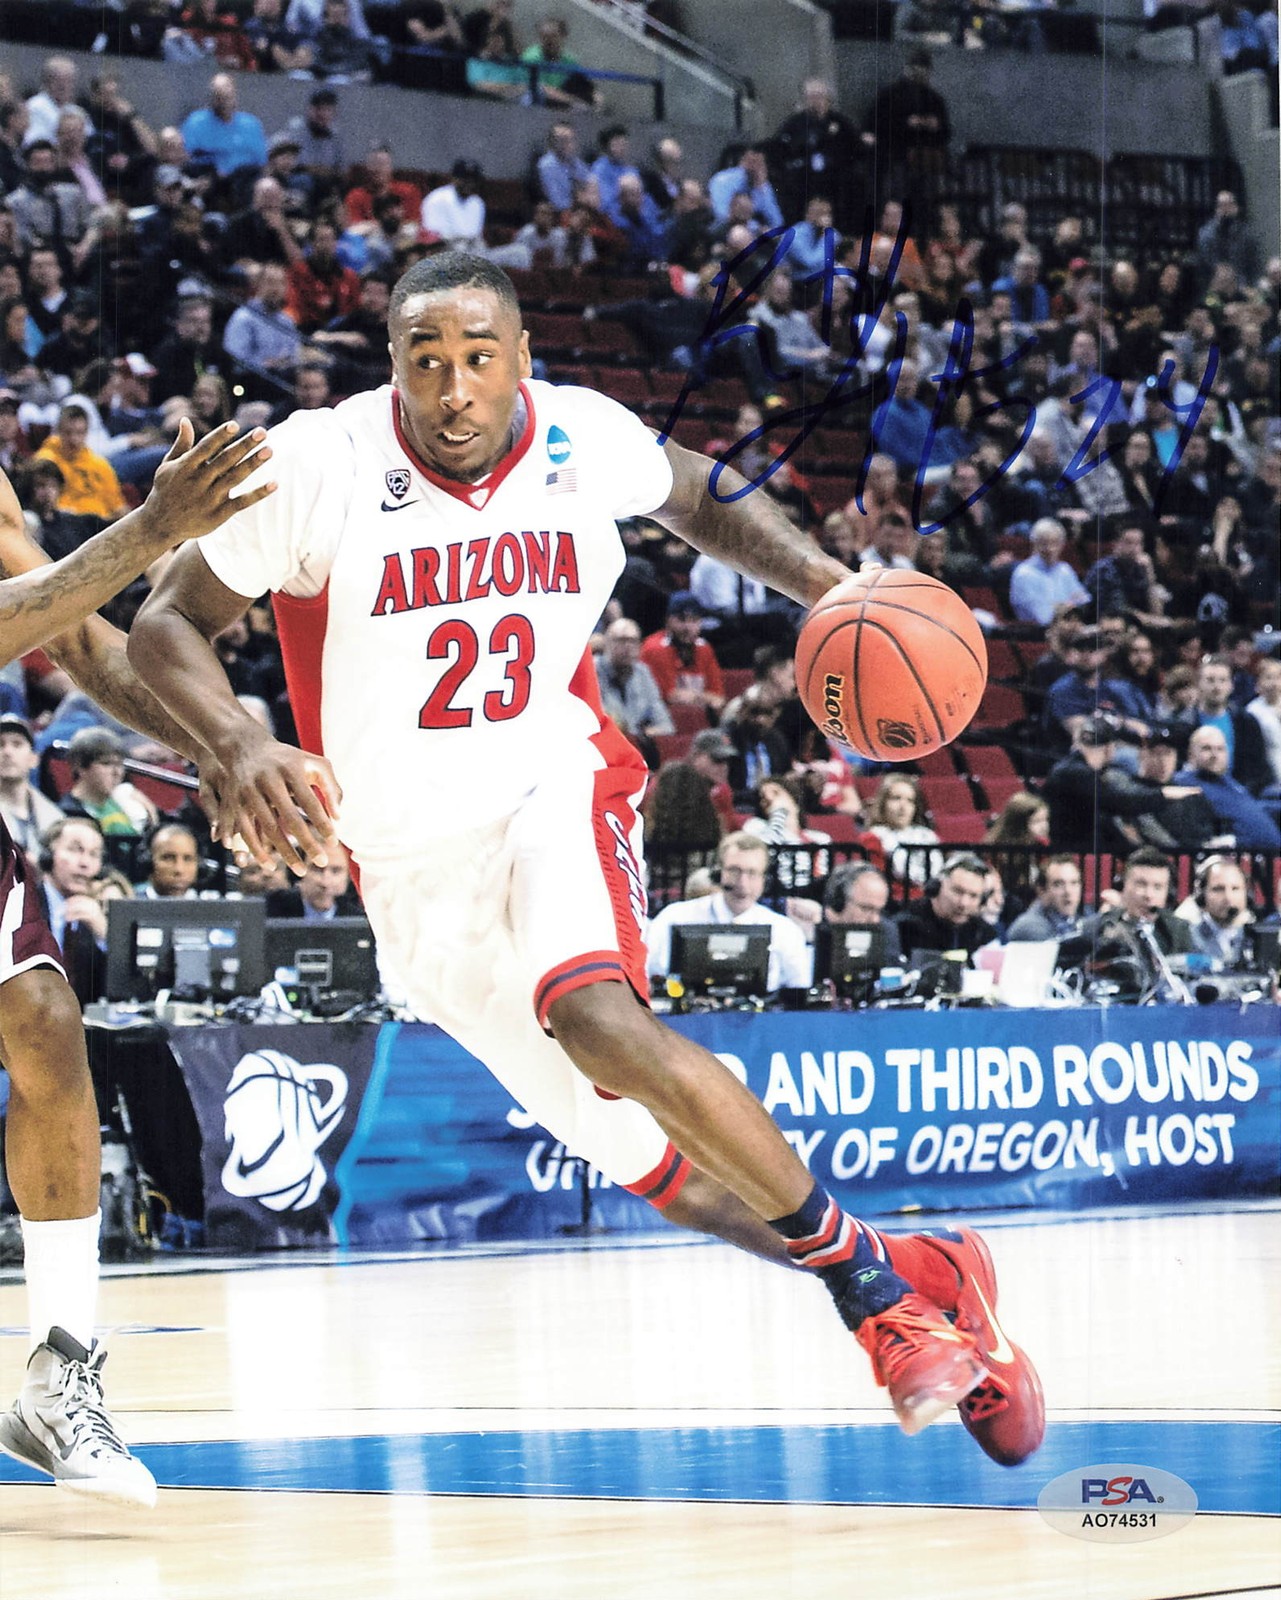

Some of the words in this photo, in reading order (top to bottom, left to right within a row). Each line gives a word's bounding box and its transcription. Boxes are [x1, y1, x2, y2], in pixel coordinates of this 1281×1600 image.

[370, 531, 581, 617] ARIZONA
[418, 613, 535, 729] 23
[762, 1050, 876, 1117] AND
[885, 1046, 1044, 1113] THIRD
[1053, 1040, 1260, 1108] ROUNDS
[831, 1127, 899, 1181] OF
[905, 1117, 1116, 1177] OREGON,
[1124, 1113, 1236, 1167] HOST
